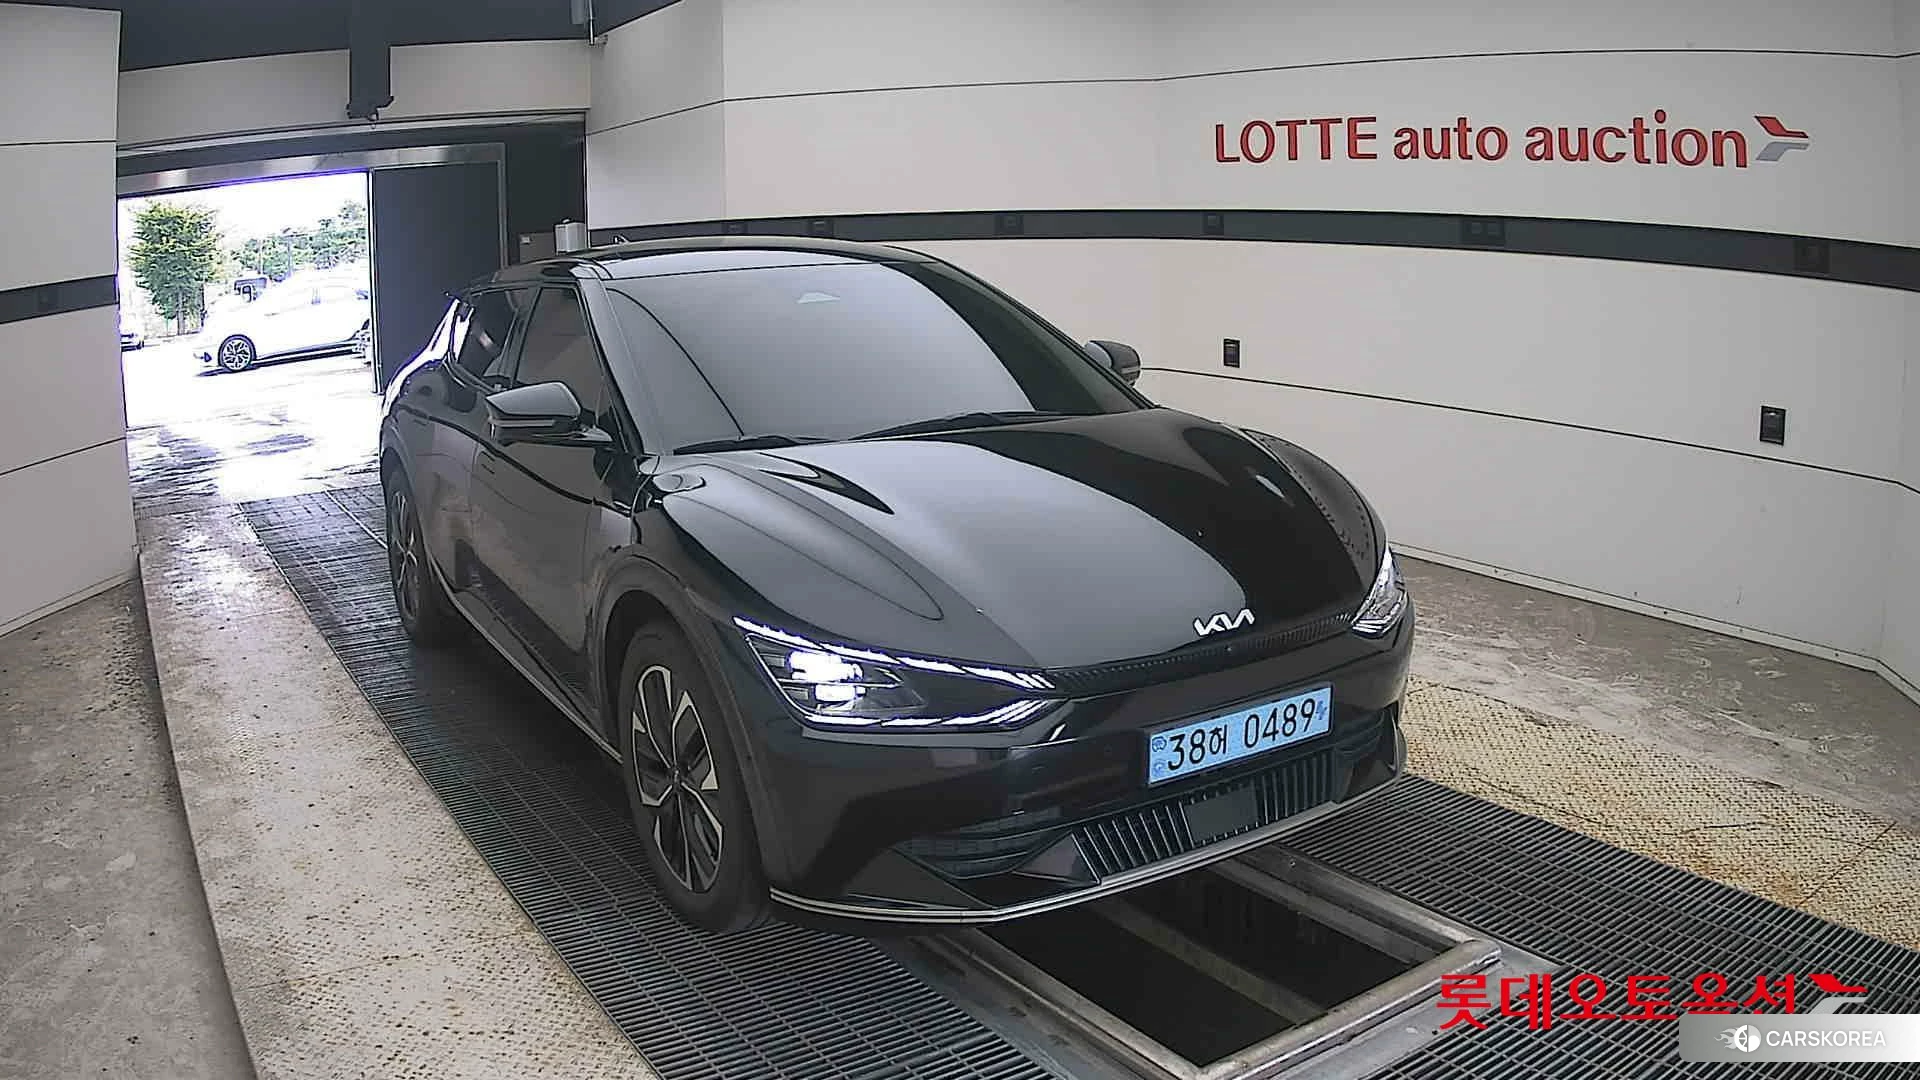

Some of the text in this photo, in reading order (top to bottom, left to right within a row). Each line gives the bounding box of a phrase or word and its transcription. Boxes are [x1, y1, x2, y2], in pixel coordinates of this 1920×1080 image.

[1215, 109, 1748, 168] LOTTE auto auction
[1167, 698, 1316, 770] 38허 0489
